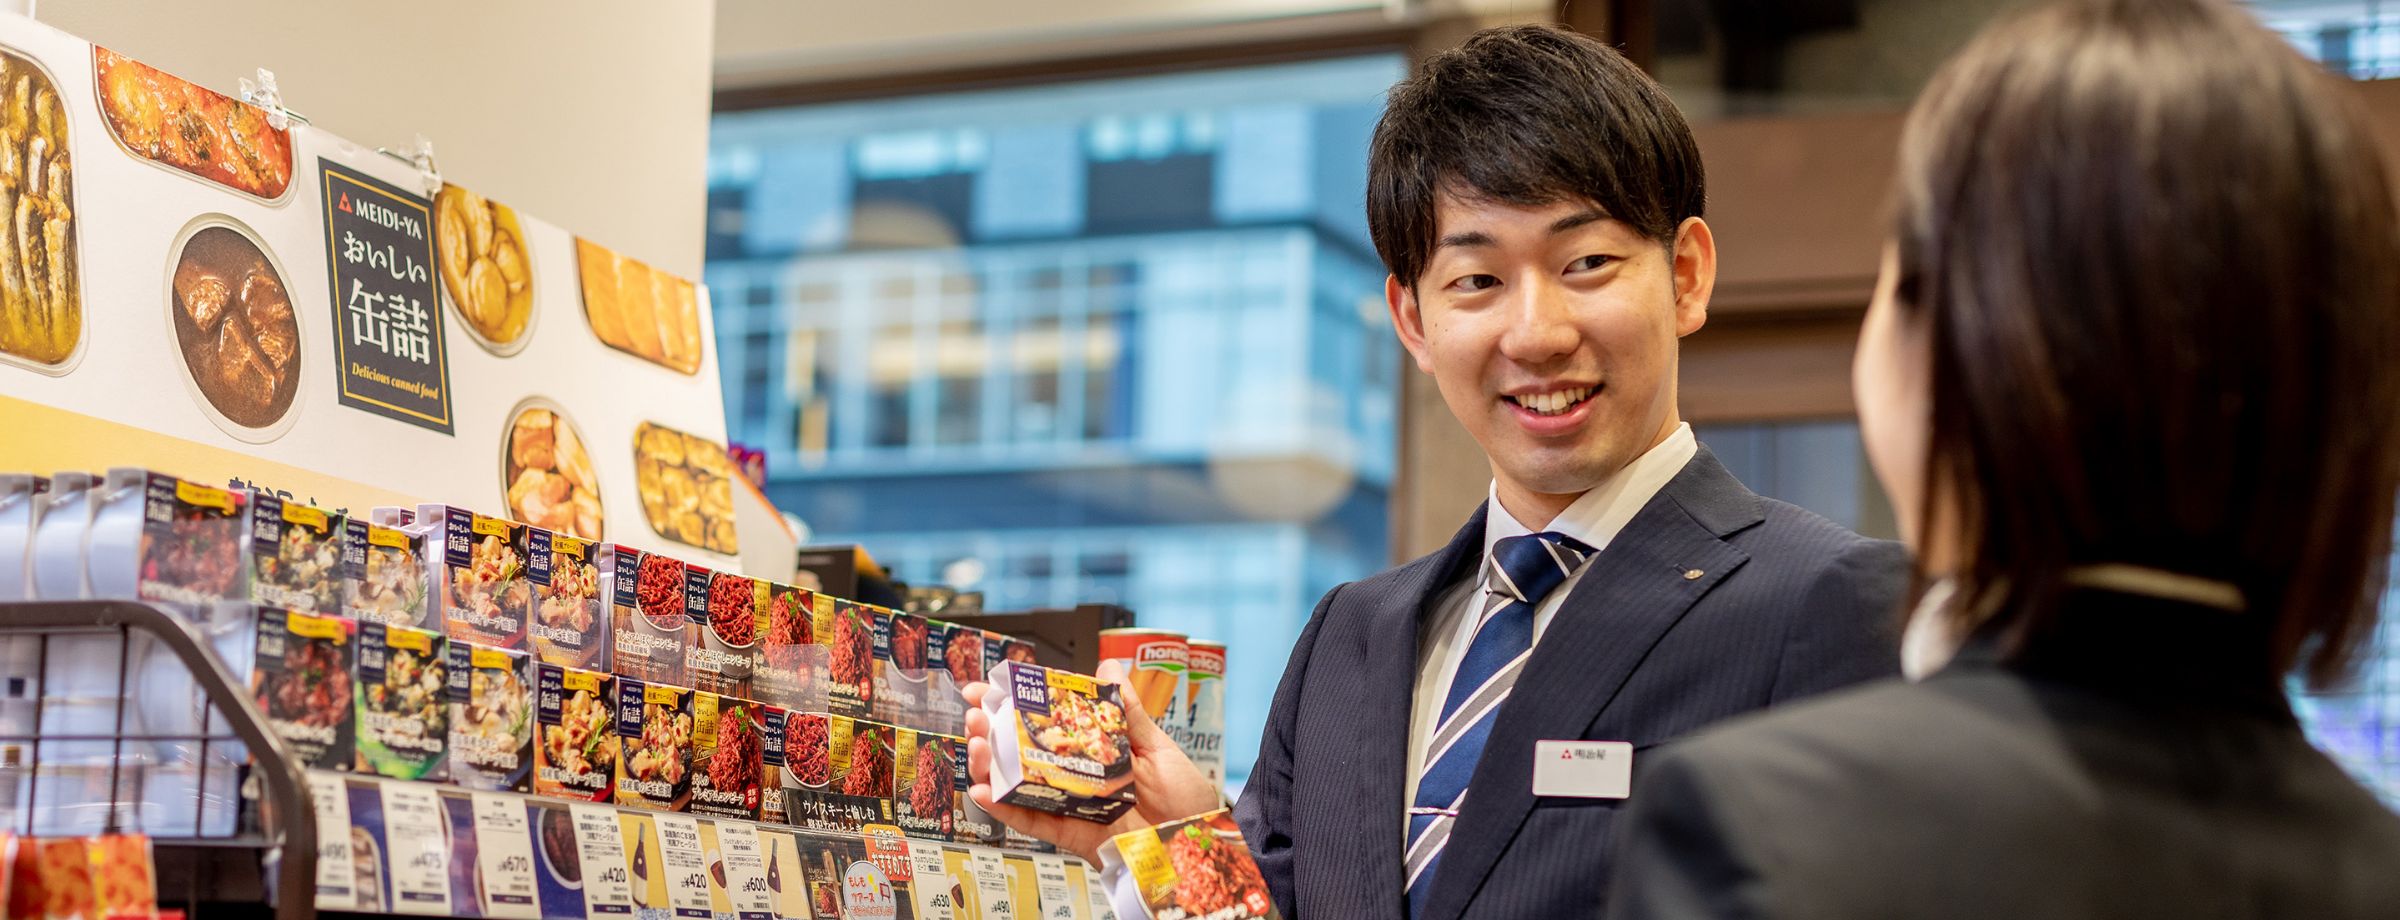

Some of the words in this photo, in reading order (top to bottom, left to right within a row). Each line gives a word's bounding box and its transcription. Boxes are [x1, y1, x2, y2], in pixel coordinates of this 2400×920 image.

[356, 199, 422, 241] MEIDI-YA
[343, 230, 427, 283] おいしい
[348, 277, 430, 365] 缶詰
[352, 361, 391, 386] Delicious
[391, 376, 420, 395] canned
[420, 384, 439, 401] food
[447, 534, 470, 553] 缶詰
[529, 551, 549, 571] 缶詰
[616, 576, 635, 594] 缶詰
[687, 594, 706, 612] 缶詰
[1015, 674, 1044, 687] おいしい
[540, 691, 561, 711] 缶詰
[1016, 684, 1045, 704] 缶詰
[621, 705, 641, 724] 缶詰
[1165, 695, 1177, 720] 4
[764, 736, 782, 753] 缶詰
[802, 799, 876, 821] ウイスキーと愉しむ
